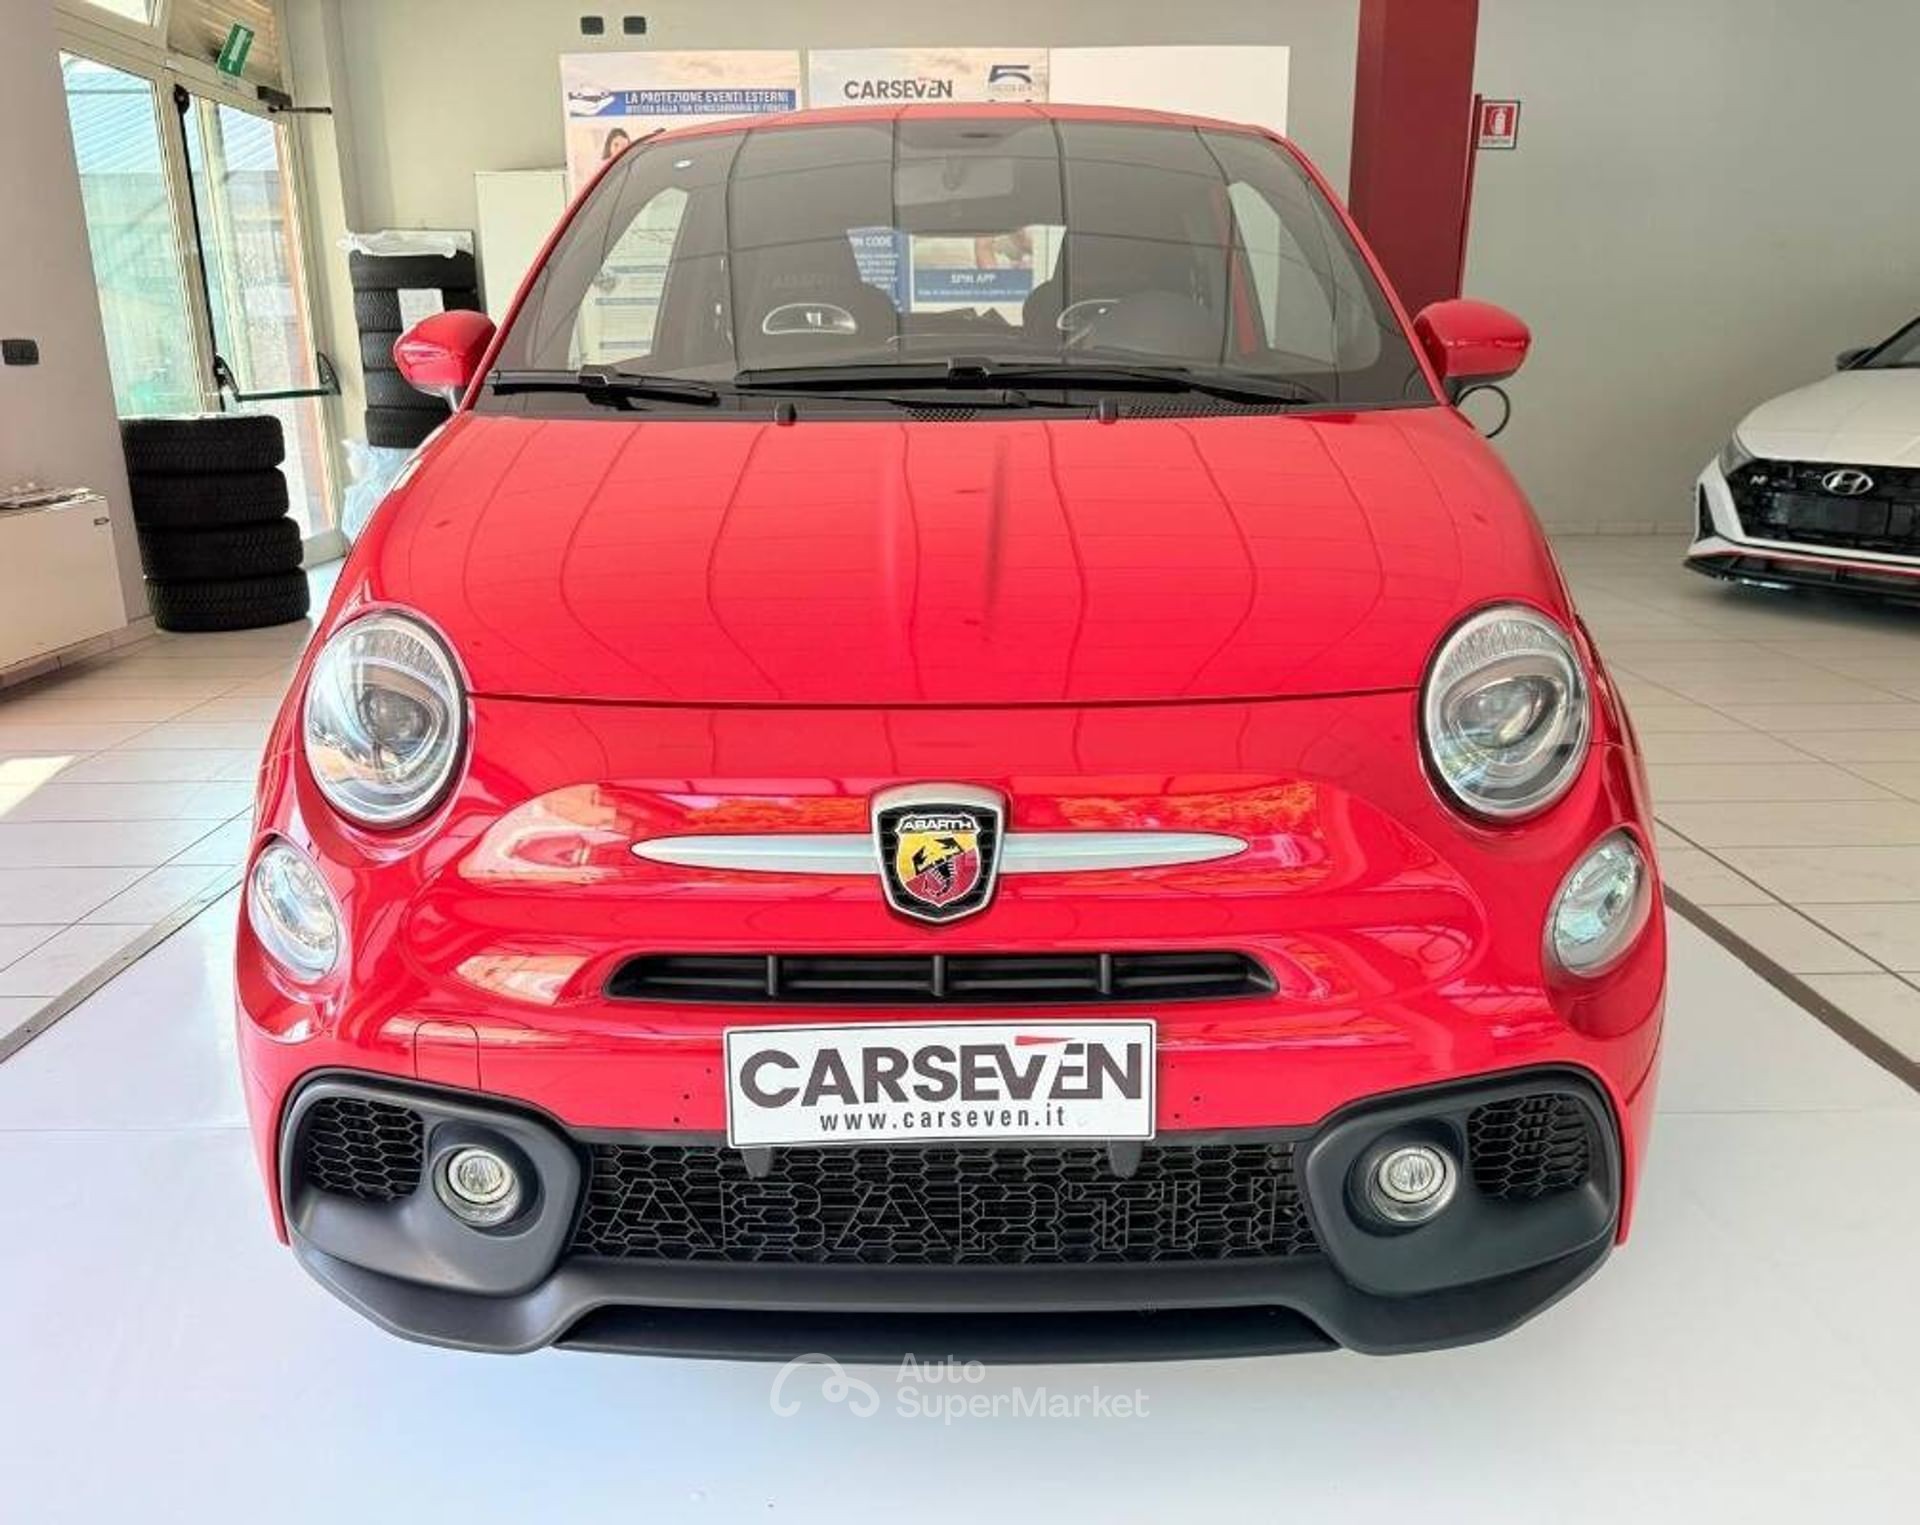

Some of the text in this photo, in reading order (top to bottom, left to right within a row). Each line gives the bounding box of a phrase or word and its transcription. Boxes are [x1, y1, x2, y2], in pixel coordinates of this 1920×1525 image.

[625, 90, 789, 104] LA PROTEZIONE EVENTI ESTERNI
[844, 78, 953, 99] CARSEVEN
[903, 819, 972, 830] ABARTH
[739, 1036, 1143, 1108] CARSEVEN
[820, 1103, 1066, 1131] www.carseven.it
[606, 1177, 1278, 1250] ABARTH
